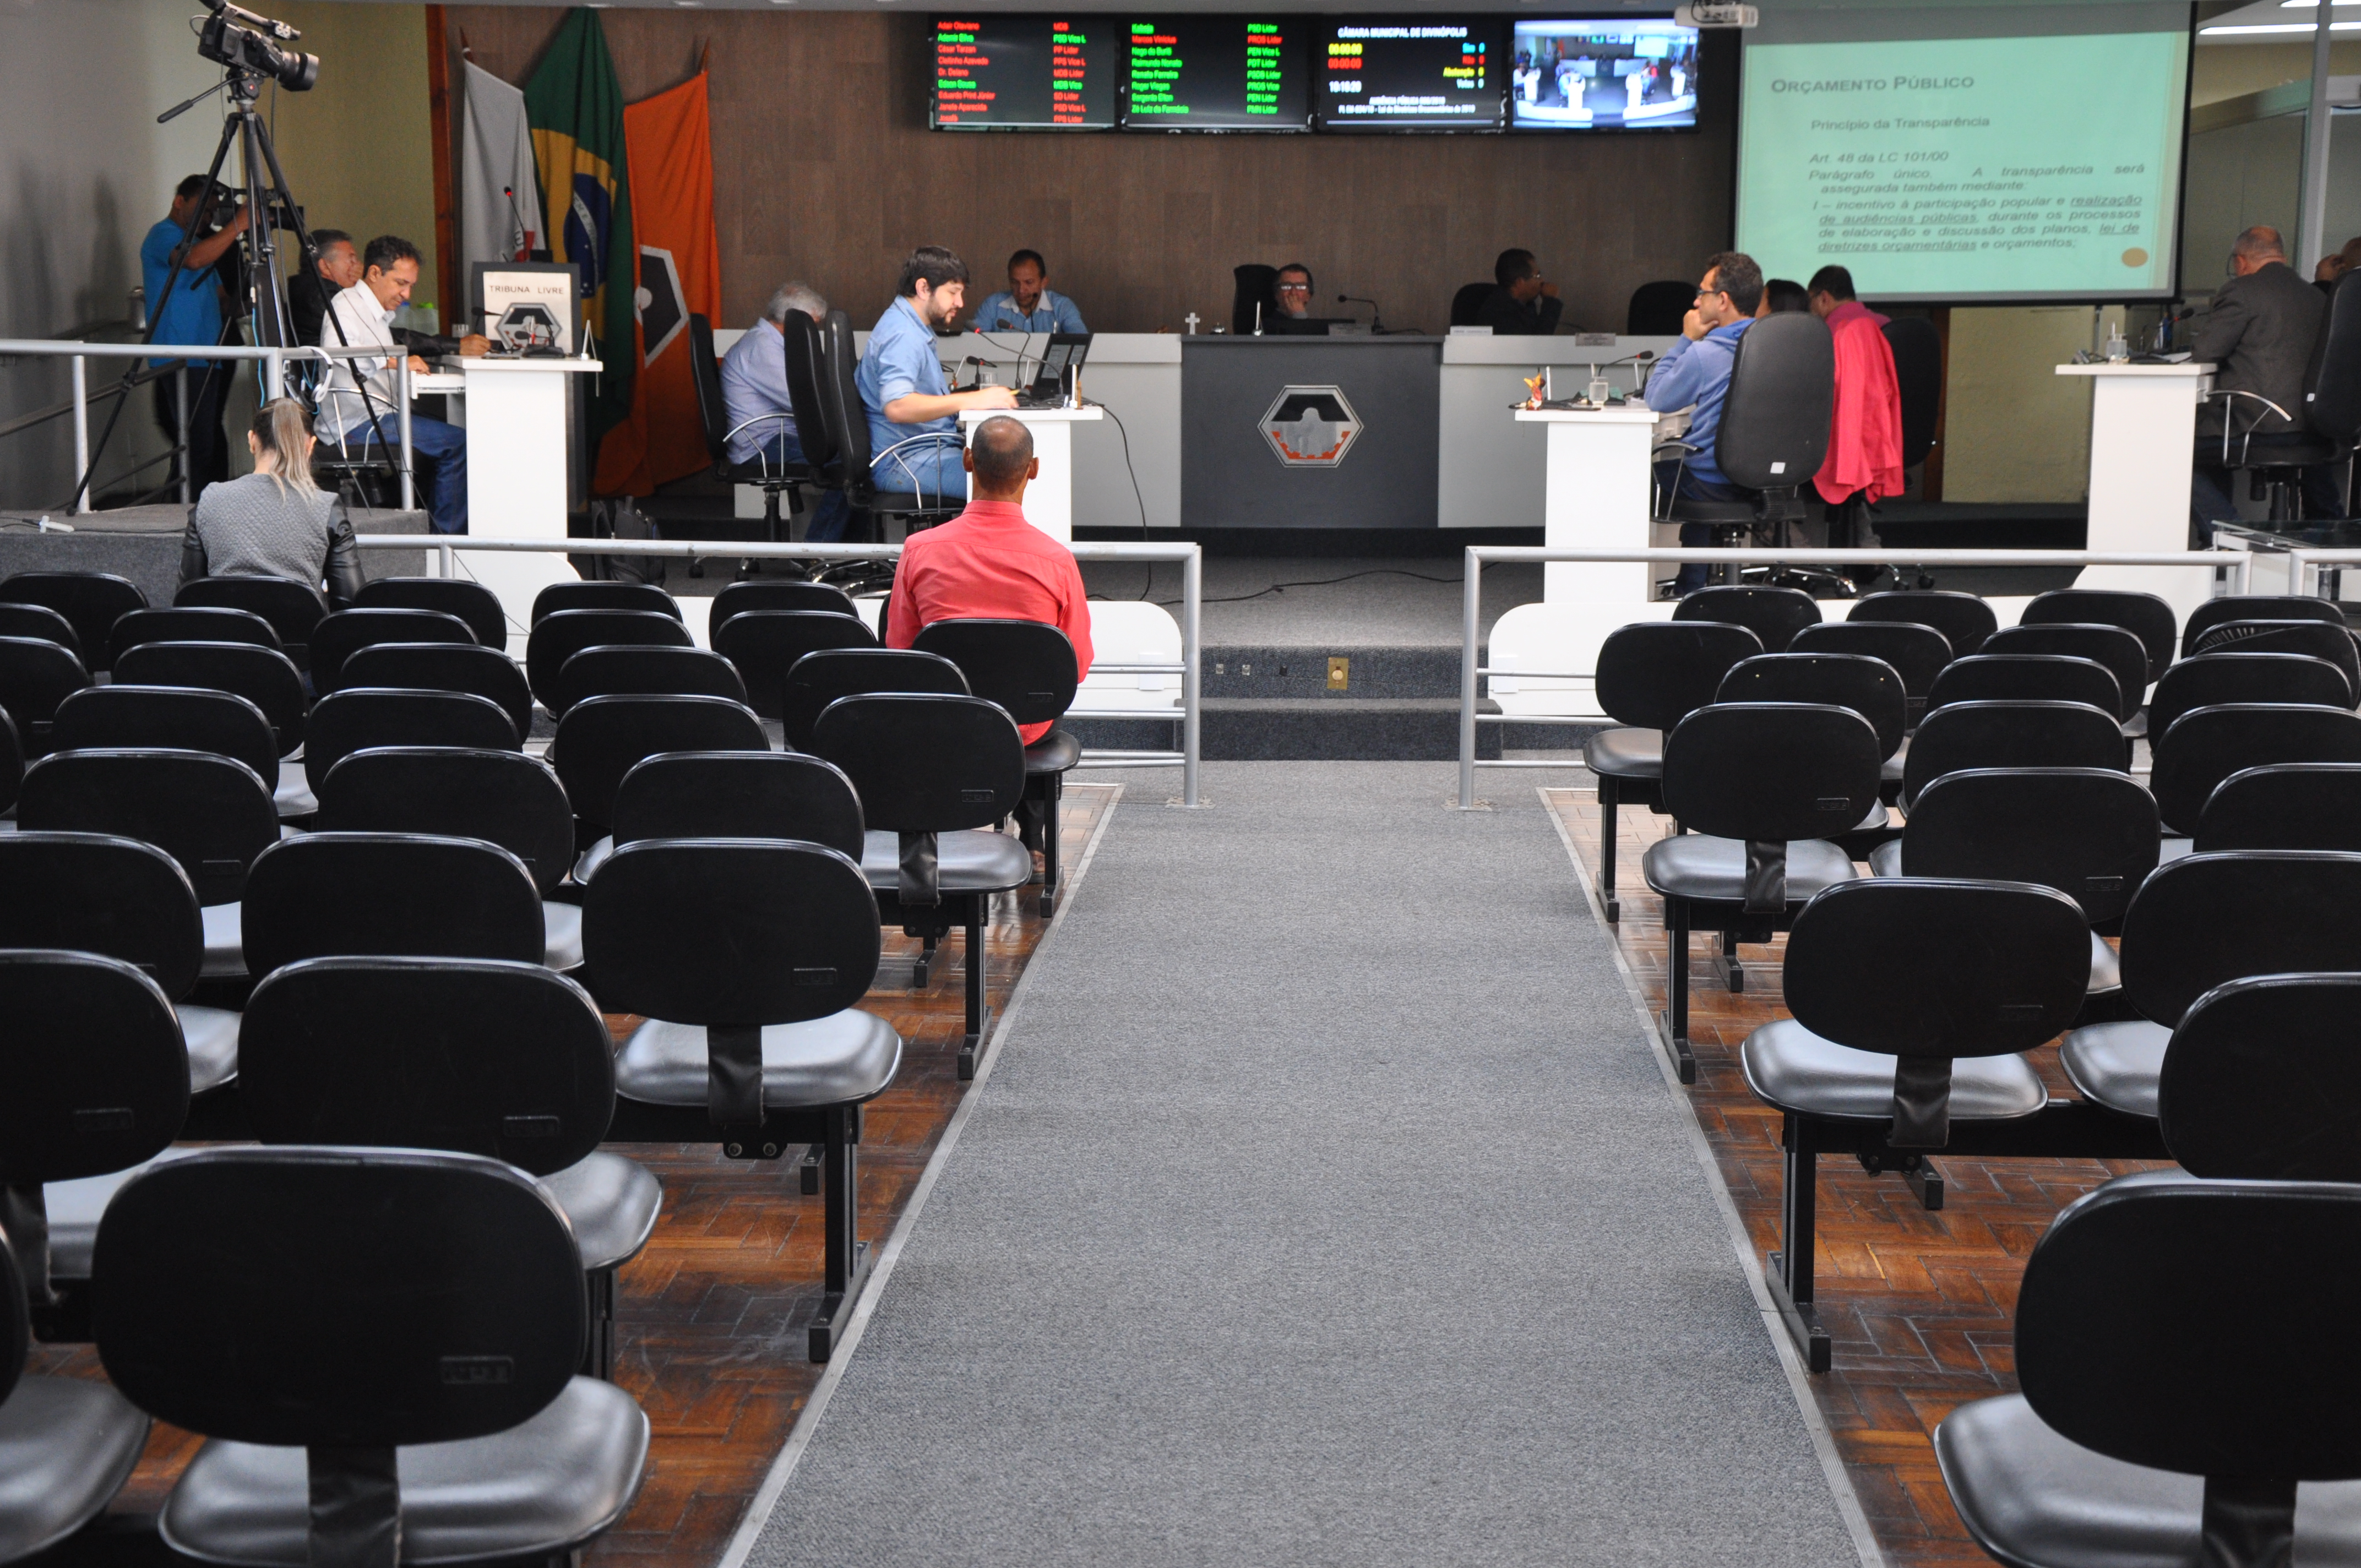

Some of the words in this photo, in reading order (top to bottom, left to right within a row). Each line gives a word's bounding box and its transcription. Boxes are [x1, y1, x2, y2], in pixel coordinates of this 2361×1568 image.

[1337, 26, 1369, 38] CÂMARA
[1771, 79, 1886, 94] ORÇAMENTO
[1894, 76, 1974, 90] PÚBLICO
[1811, 119, 1869, 132] Princípio
[1874, 119, 1890, 129] da
[1894, 117, 1990, 129] Transparência
[1837, 153, 1854, 162] 48
[1858, 153, 1875, 162] da
[1878, 152, 1899, 162] LC
[1903, 151, 1949, 162] 101/00
[1809, 170, 1874, 181] Parágrafo
[1972, 167, 1982, 177] A
[2001, 166, 2093, 177] transparência
[2114, 164, 2145, 174] será
[1821, 183, 1898, 195] assegurada
[1903, 182, 1957, 192] também
[1836, 200, 1895, 210] incentivo
[1913, 197, 1996, 210] participação
[2000, 197, 2052, 208] popular
[2070, 194, 2142, 207] realização
[1819, 215, 1836, 225] de
[1843, 214, 1914, 224] audiências
[1988, 211, 2039, 221] durante
[2046, 211, 2062, 220] os
[2069, 210, 2140, 221] processos
[1819, 228, 1835, 237] de
[1842, 227, 1916, 238] elaboração
[1938, 225, 2005, 236] discussão
[2012, 225, 2036, 235] dos
[2099, 223, 2115, 233] lei
[2122, 223, 2140, 233] de
[1819, 243, 1878, 252] diretrizes
[1882, 241, 1977, 252] orçamentárias
[537, 286, 564, 295] LIVRE
